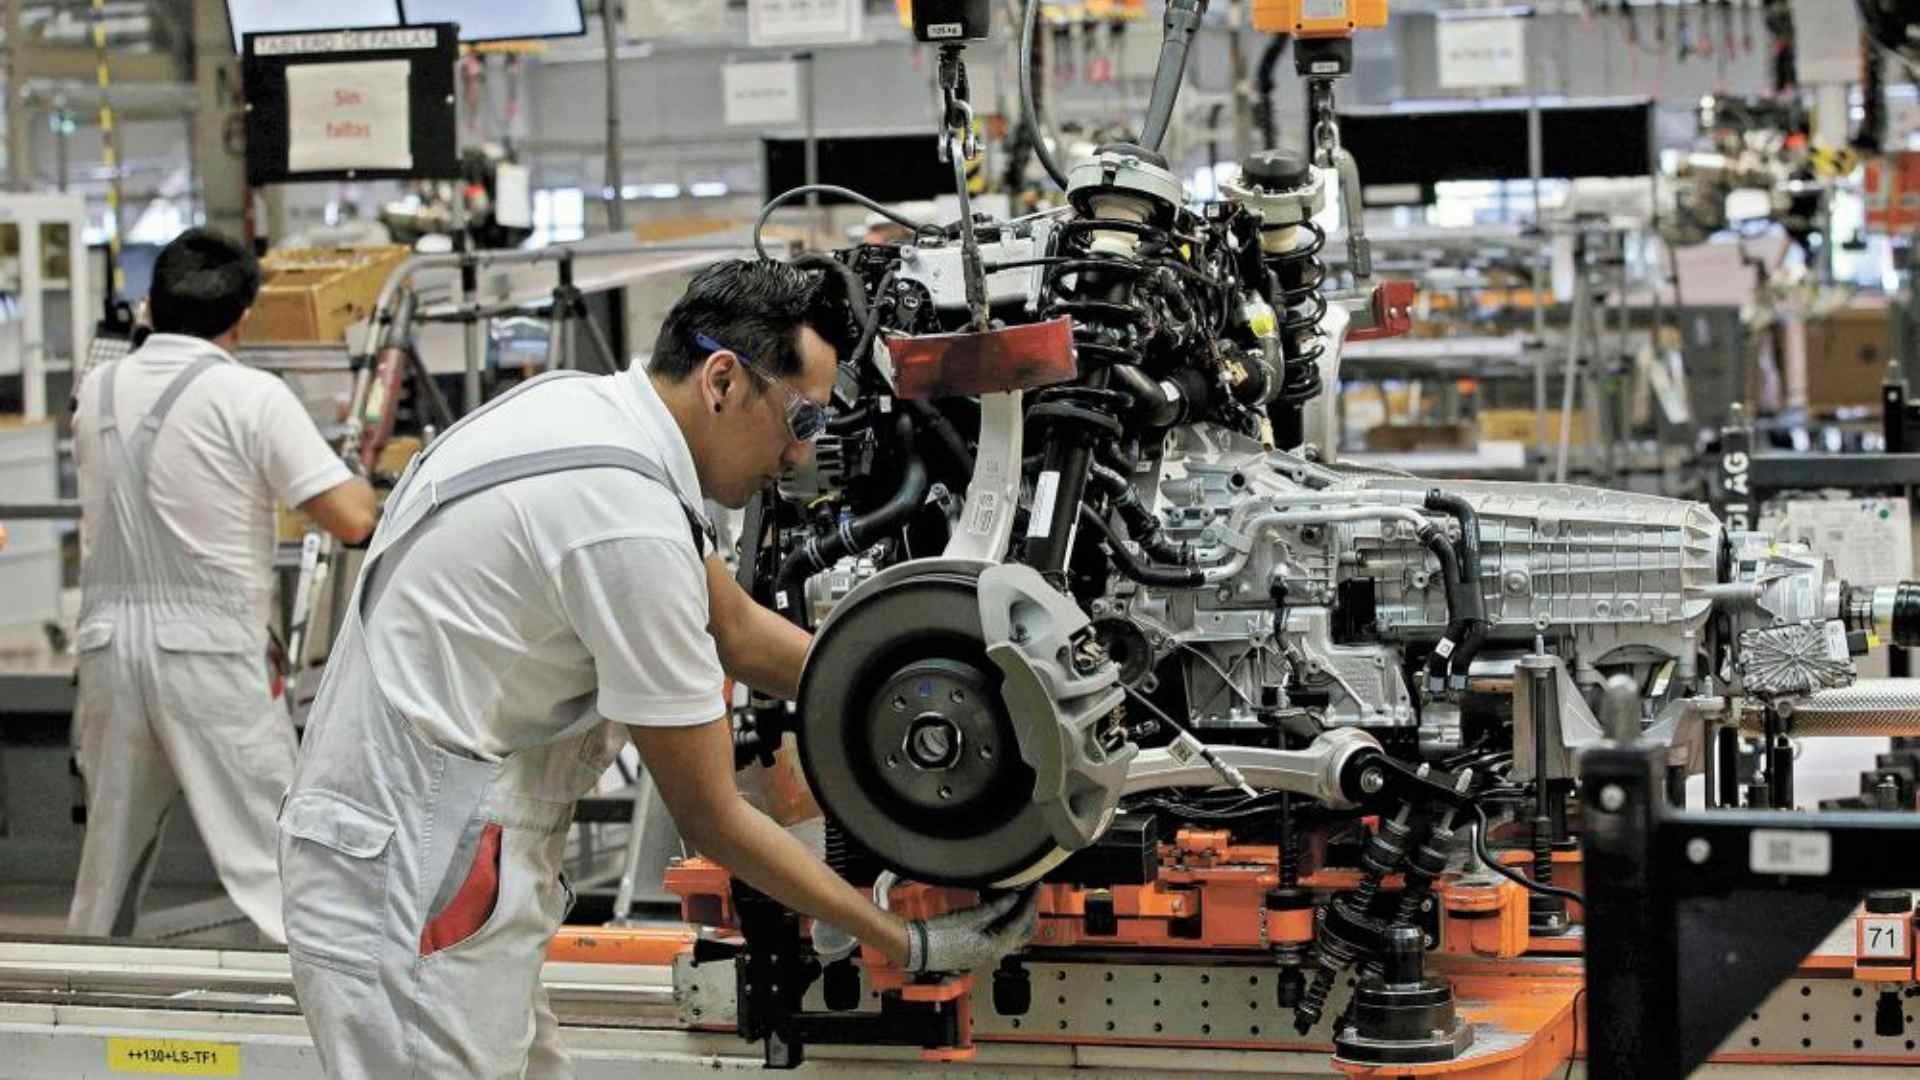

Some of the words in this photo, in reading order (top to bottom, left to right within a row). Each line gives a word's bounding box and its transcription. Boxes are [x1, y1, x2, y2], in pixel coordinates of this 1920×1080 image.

[256, 35, 335, 53] TABLERO
[344, 33, 365, 50] DE
[371, 30, 435, 48] FALLAS
[335, 89, 361, 107] Sin
[325, 121, 370, 139] fallas
[1723, 452, 1749, 495] AG
[1868, 927, 1894, 949] 71
